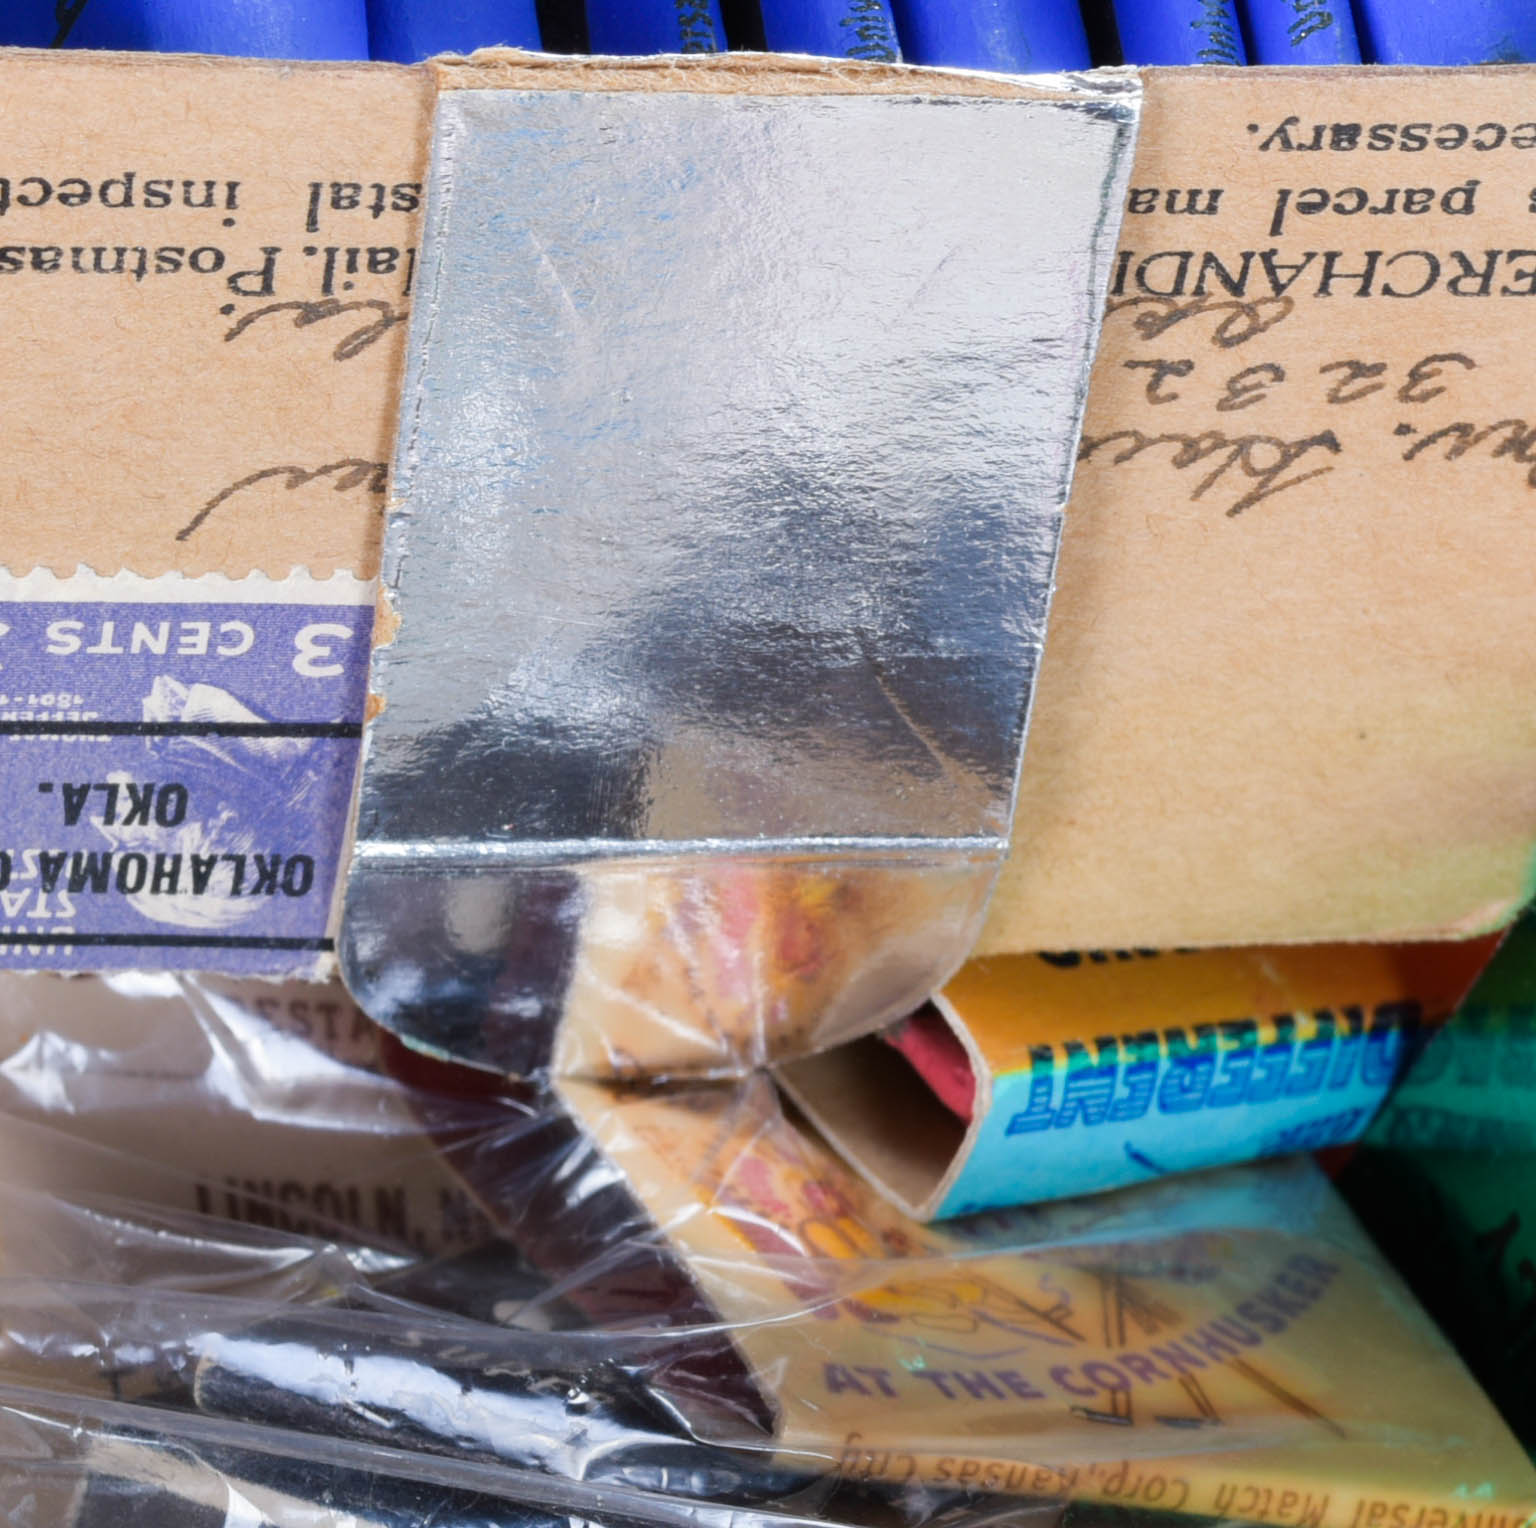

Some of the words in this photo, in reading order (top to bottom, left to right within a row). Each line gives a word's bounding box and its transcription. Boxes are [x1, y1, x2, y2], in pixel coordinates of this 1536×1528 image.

[306, 179, 423, 234] stal
[1127, 184, 1225, 218] ma
[1269, 179, 1483, 238] parcel
[45, 620, 256, 657] CENTS
[290, 622, 356, 678] 3
[37, 782, 189, 827] OKLA.
[33, 851, 315, 898] OKLAHOMA
[1005, 1001, 1422, 1139] DIFFERENT
[821, 1361, 899, 1402] AT
[917, 1367, 1046, 1403] THE
[1049, 1251, 1342, 1401] CORNHUSKER
[836, 1432, 918, 1482] City
[934, 1455, 1080, 1497] Kansas
[1213, 1479, 1331, 1528] Match
